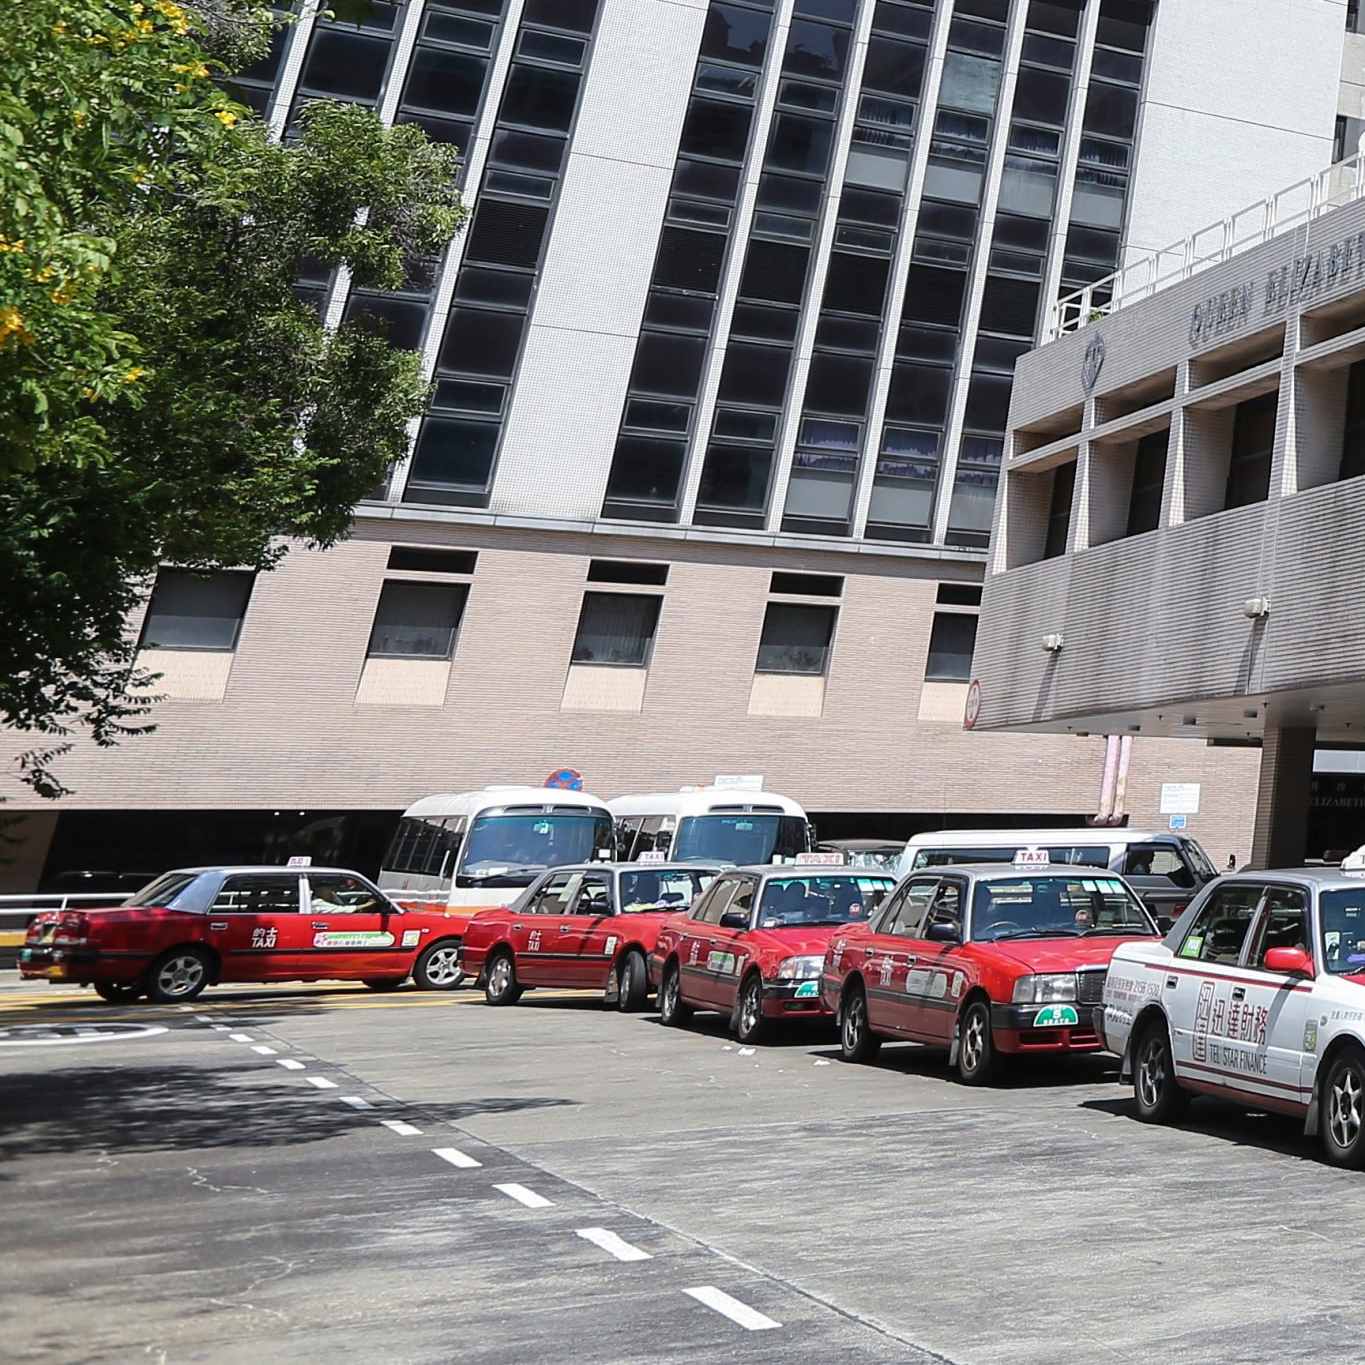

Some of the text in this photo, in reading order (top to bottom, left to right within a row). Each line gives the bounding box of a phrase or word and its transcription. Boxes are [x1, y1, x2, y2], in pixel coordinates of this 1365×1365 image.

[1190, 282, 1254, 335] QUEEN
[800, 854, 841, 864] TAXI
[1020, 852, 1047, 862] TAXI
[253, 927, 279, 938] 的士
[251, 937, 276, 948] TAXI
[527, 940, 540, 951] TAXI
[1211, 998, 1269, 1046] 迅達財務
[1223, 1046, 1238, 1068] STAR
[1240, 1050, 1268, 1075] FINANCE
